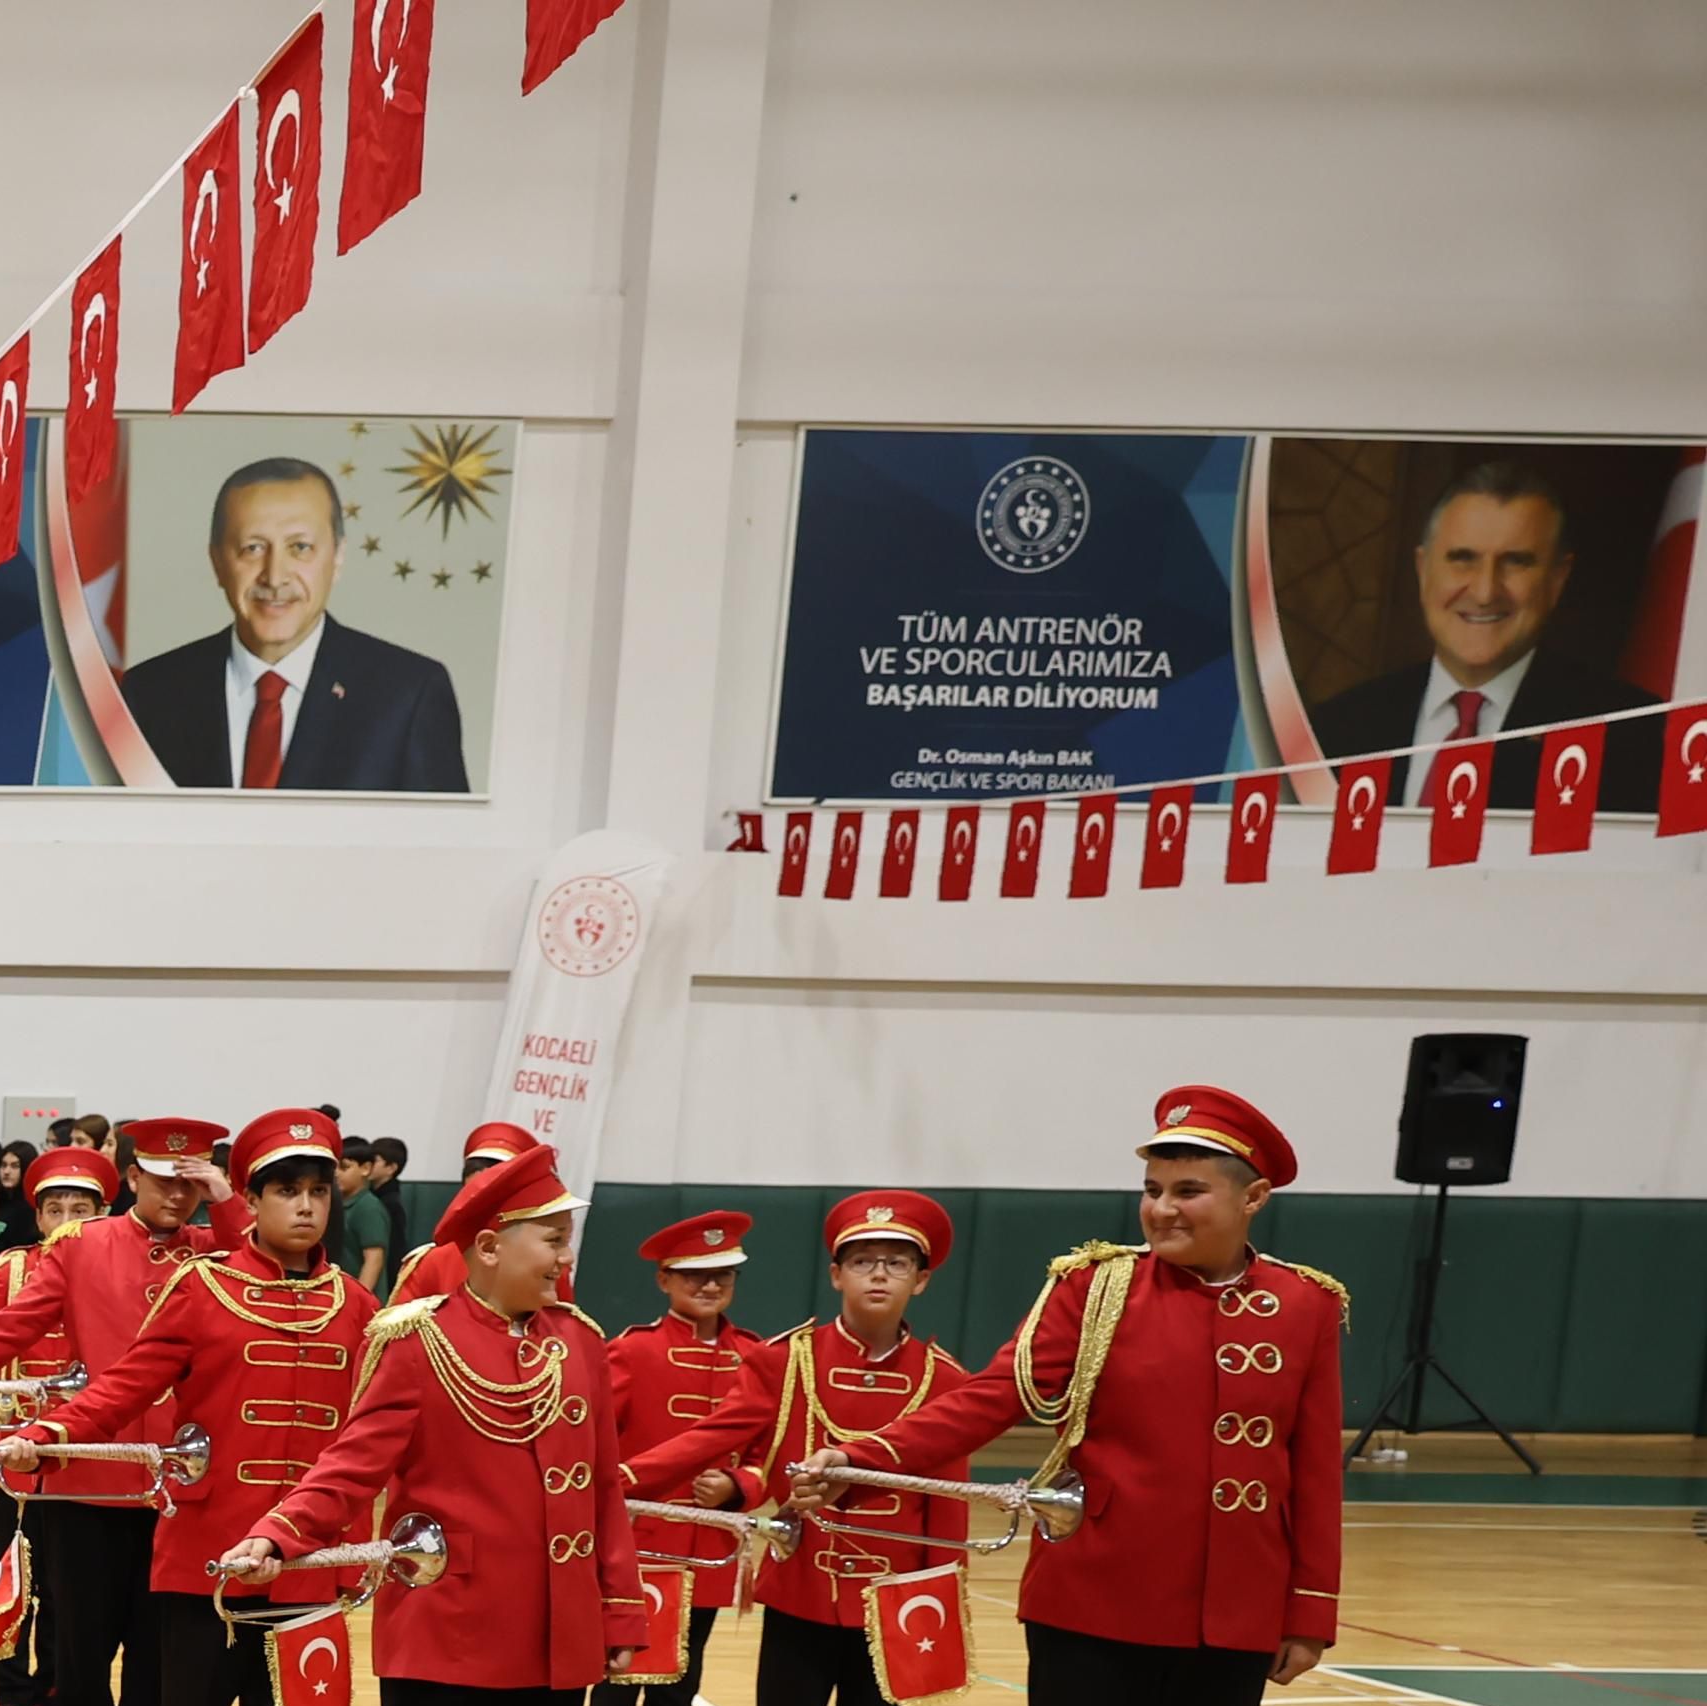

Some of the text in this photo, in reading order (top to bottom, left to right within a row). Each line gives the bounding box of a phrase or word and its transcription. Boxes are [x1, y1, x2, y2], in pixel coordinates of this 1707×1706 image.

[898, 610, 1143, 645] TÜM ANTRENÖR
[860, 646, 1172, 678] VE SPORCULARIMIZA
[866, 681, 1158, 712] BAŞARILAR DİLİYORUM
[918, 748, 1093, 769] Dr. Osman Aşkın BAK
[890, 769, 1115, 793] GENÇLİK VE SPOR BAKANI
[521, 1033, 597, 1066] KOCAELİ
[513, 1069, 589, 1101] GENÇLİK
[532, 1108, 556, 1133] VE
